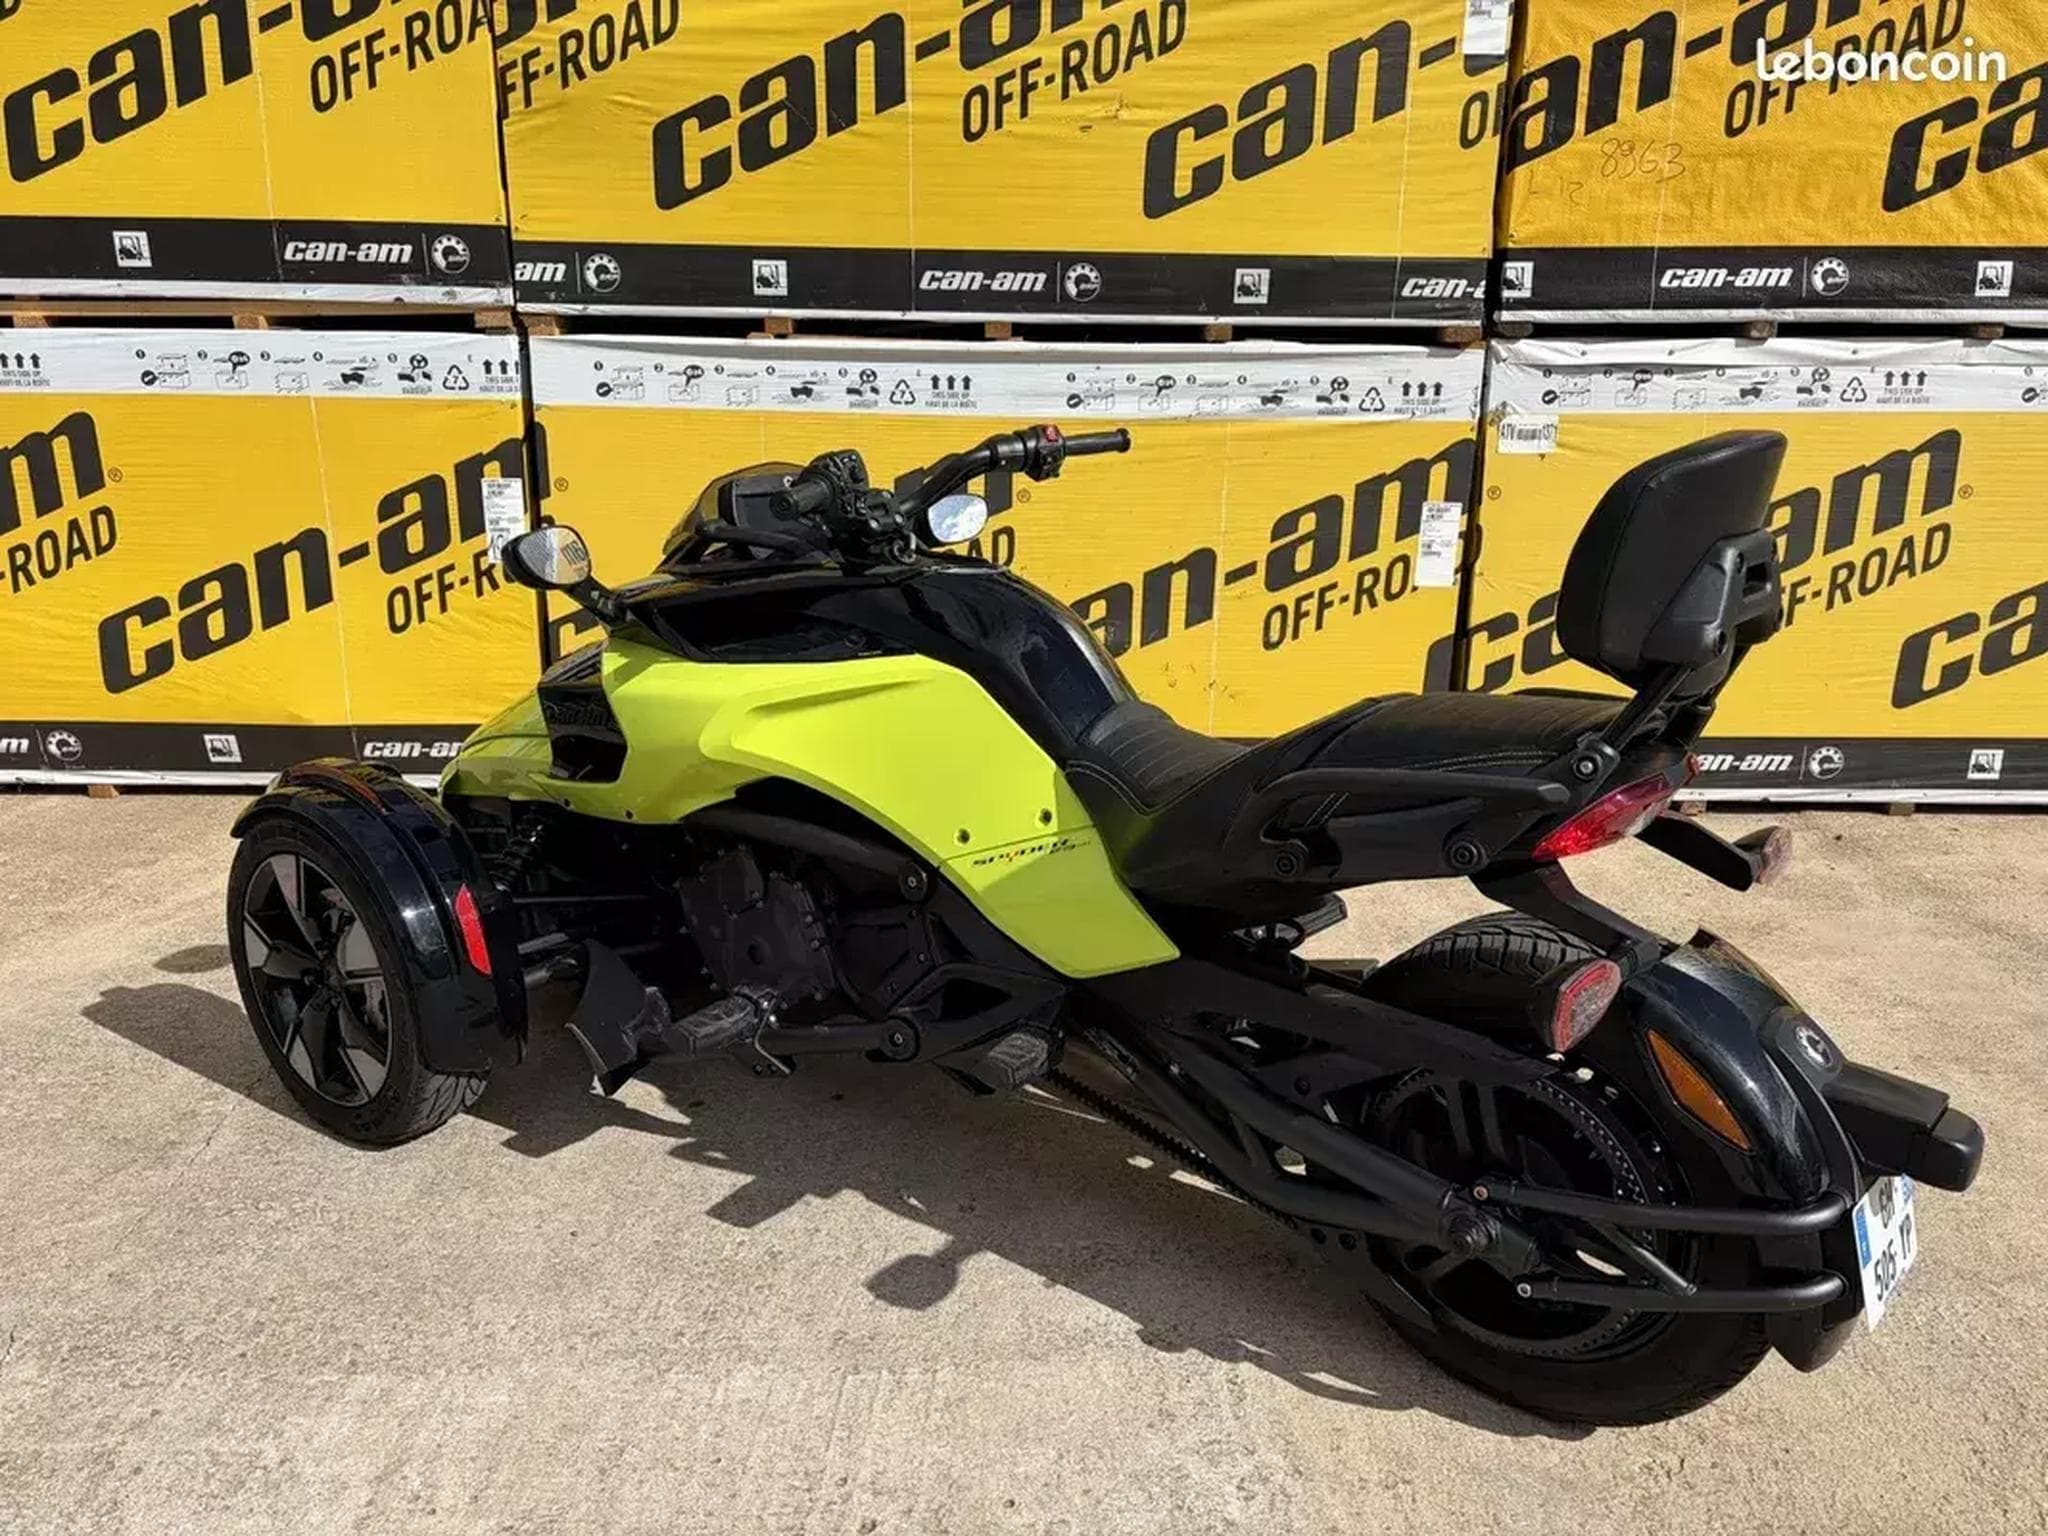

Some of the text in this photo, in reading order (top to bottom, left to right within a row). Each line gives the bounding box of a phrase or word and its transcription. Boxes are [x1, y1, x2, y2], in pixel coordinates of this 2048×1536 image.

[963, 0, 1187, 143] OFF-ROAD
[1600, 137, 1687, 184] 8963
[285, 241, 413, 263] can-am
[919, 270, 1047, 291] can-am
[1660, 266, 1793, 287] can-am
